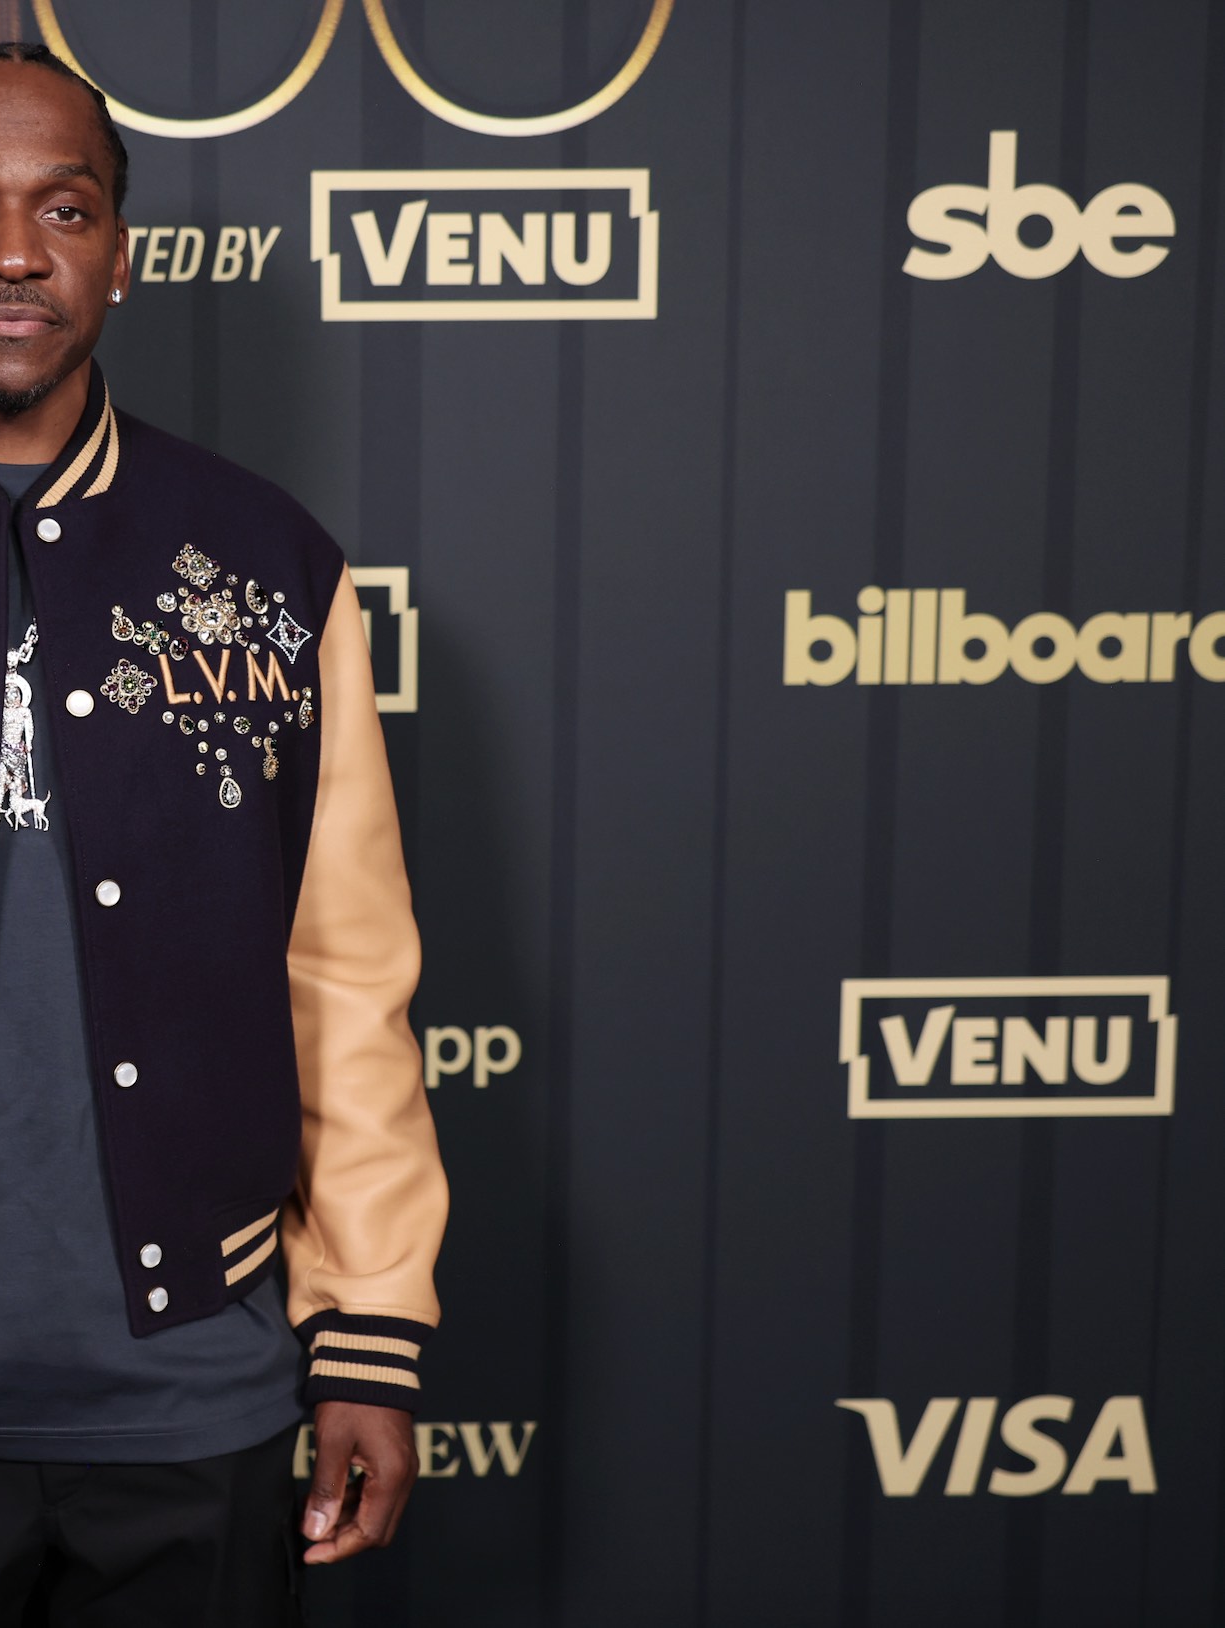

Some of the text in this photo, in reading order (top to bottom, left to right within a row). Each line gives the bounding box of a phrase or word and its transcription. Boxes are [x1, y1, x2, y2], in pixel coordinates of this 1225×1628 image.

[350, 200, 612, 286] VENU
[902, 130, 1176, 281] sbe
[210, 226, 282, 282] BY
[424, 1025, 522, 1089] pp
[879, 1005, 1132, 1086] VENU
[835, 1395, 1157, 1497] VISA
